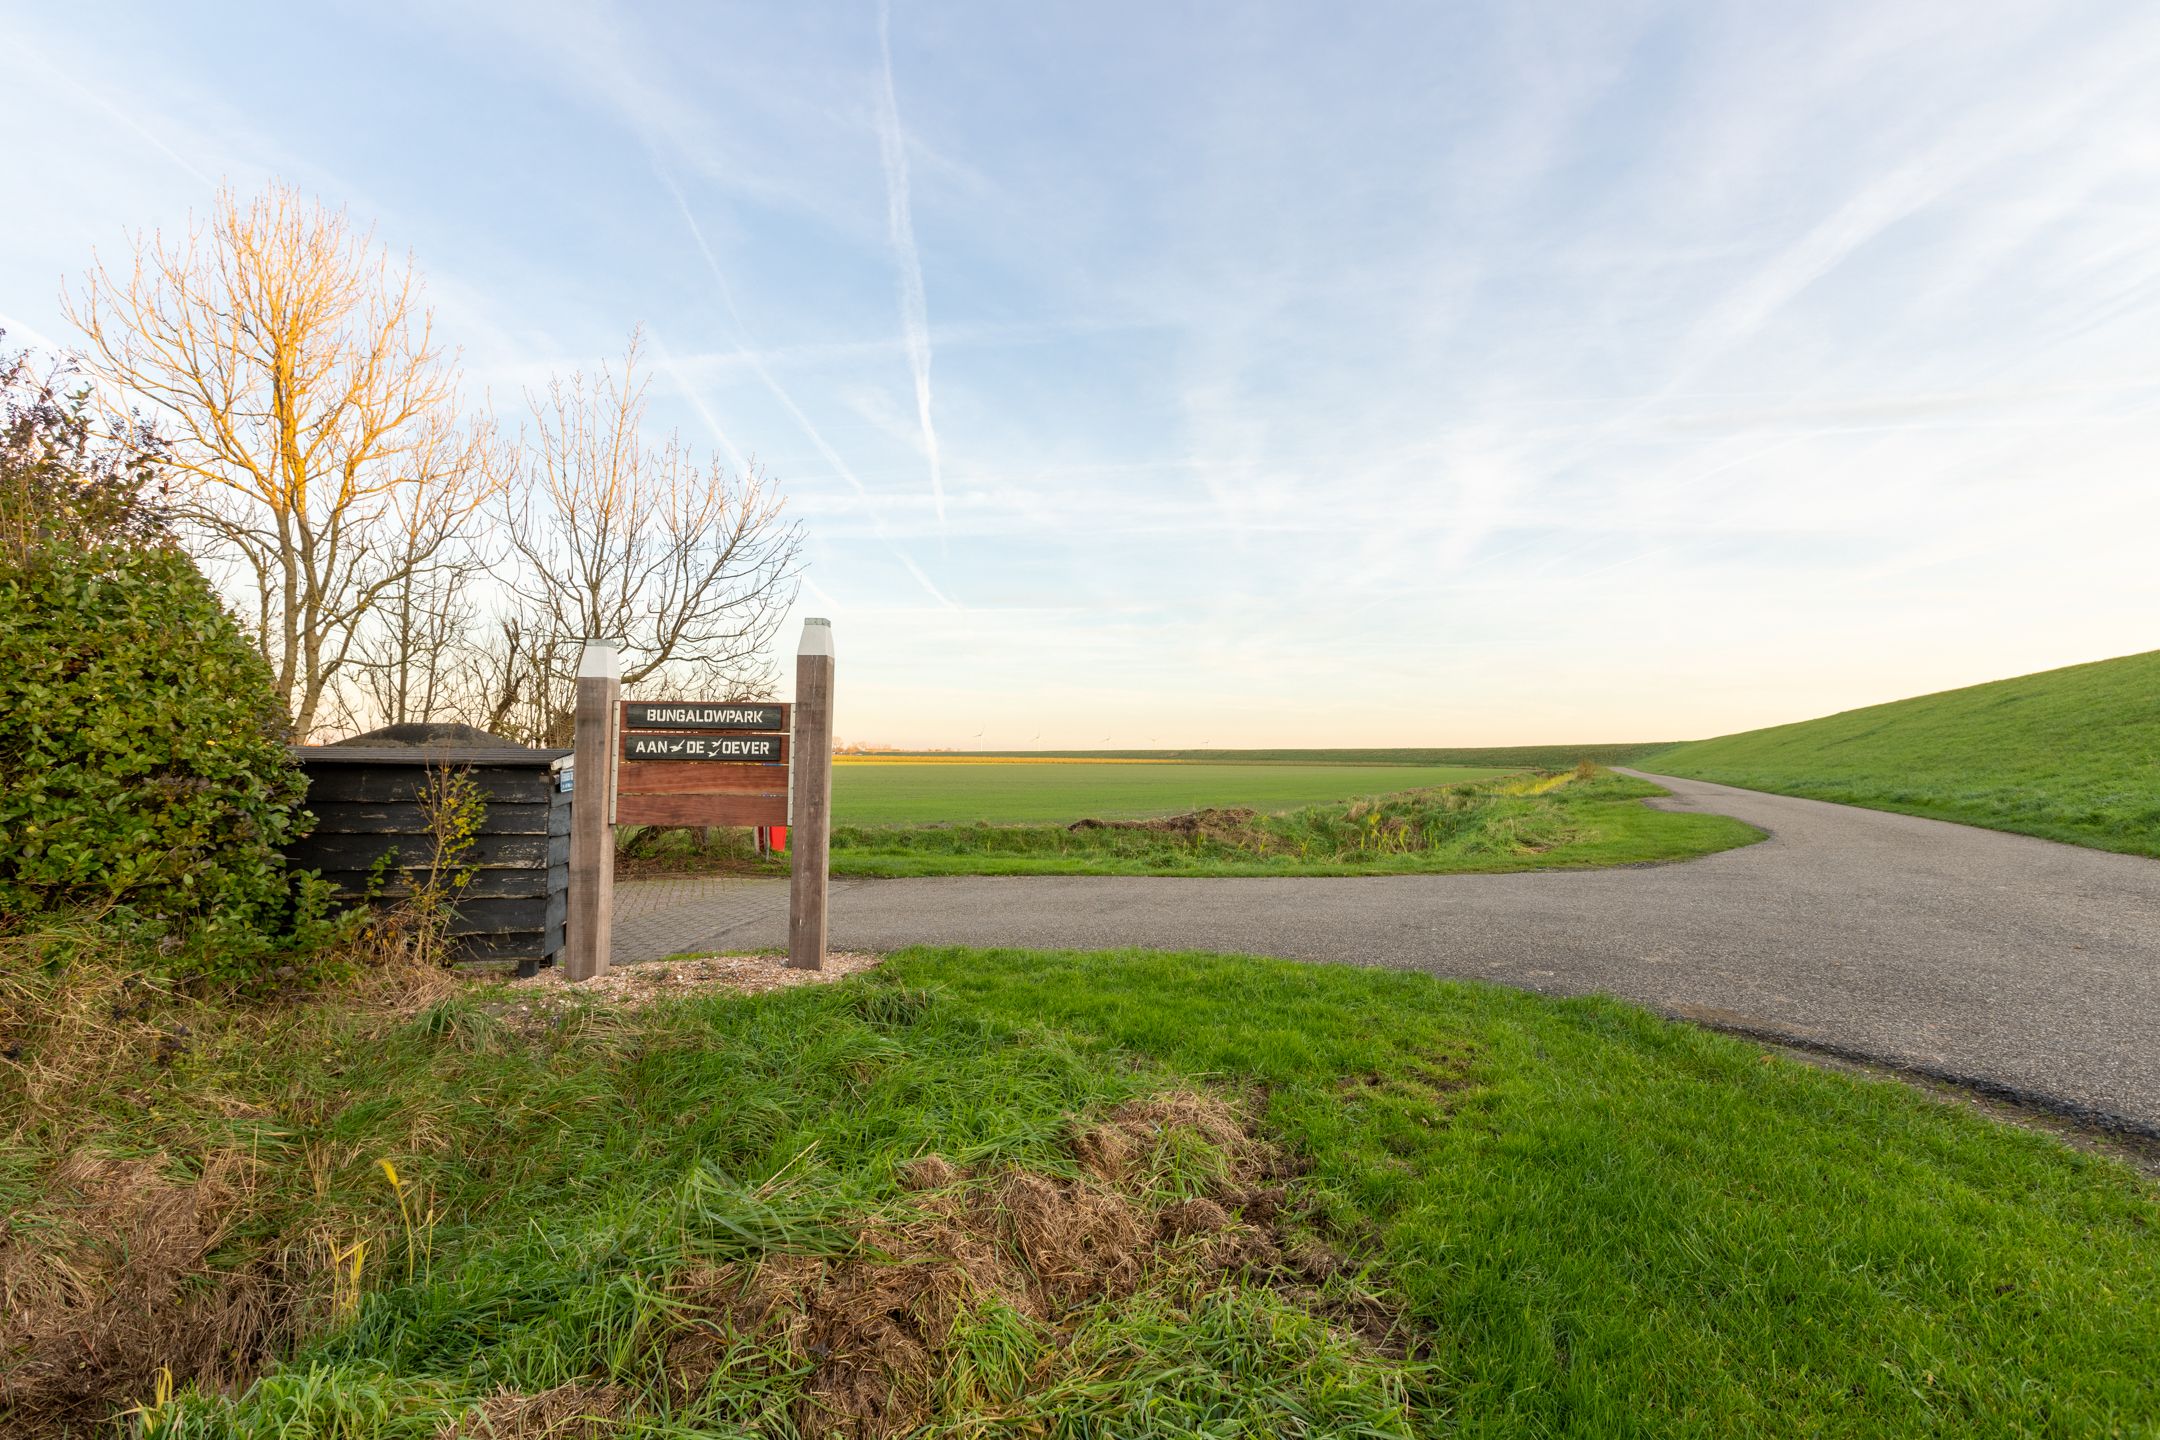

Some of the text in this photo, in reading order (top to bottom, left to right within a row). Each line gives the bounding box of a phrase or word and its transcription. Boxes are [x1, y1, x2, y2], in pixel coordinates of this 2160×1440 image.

[647, 709, 763, 723] BUNGALOWPARK
[635, 741, 769, 754] AAN DE OEVER
